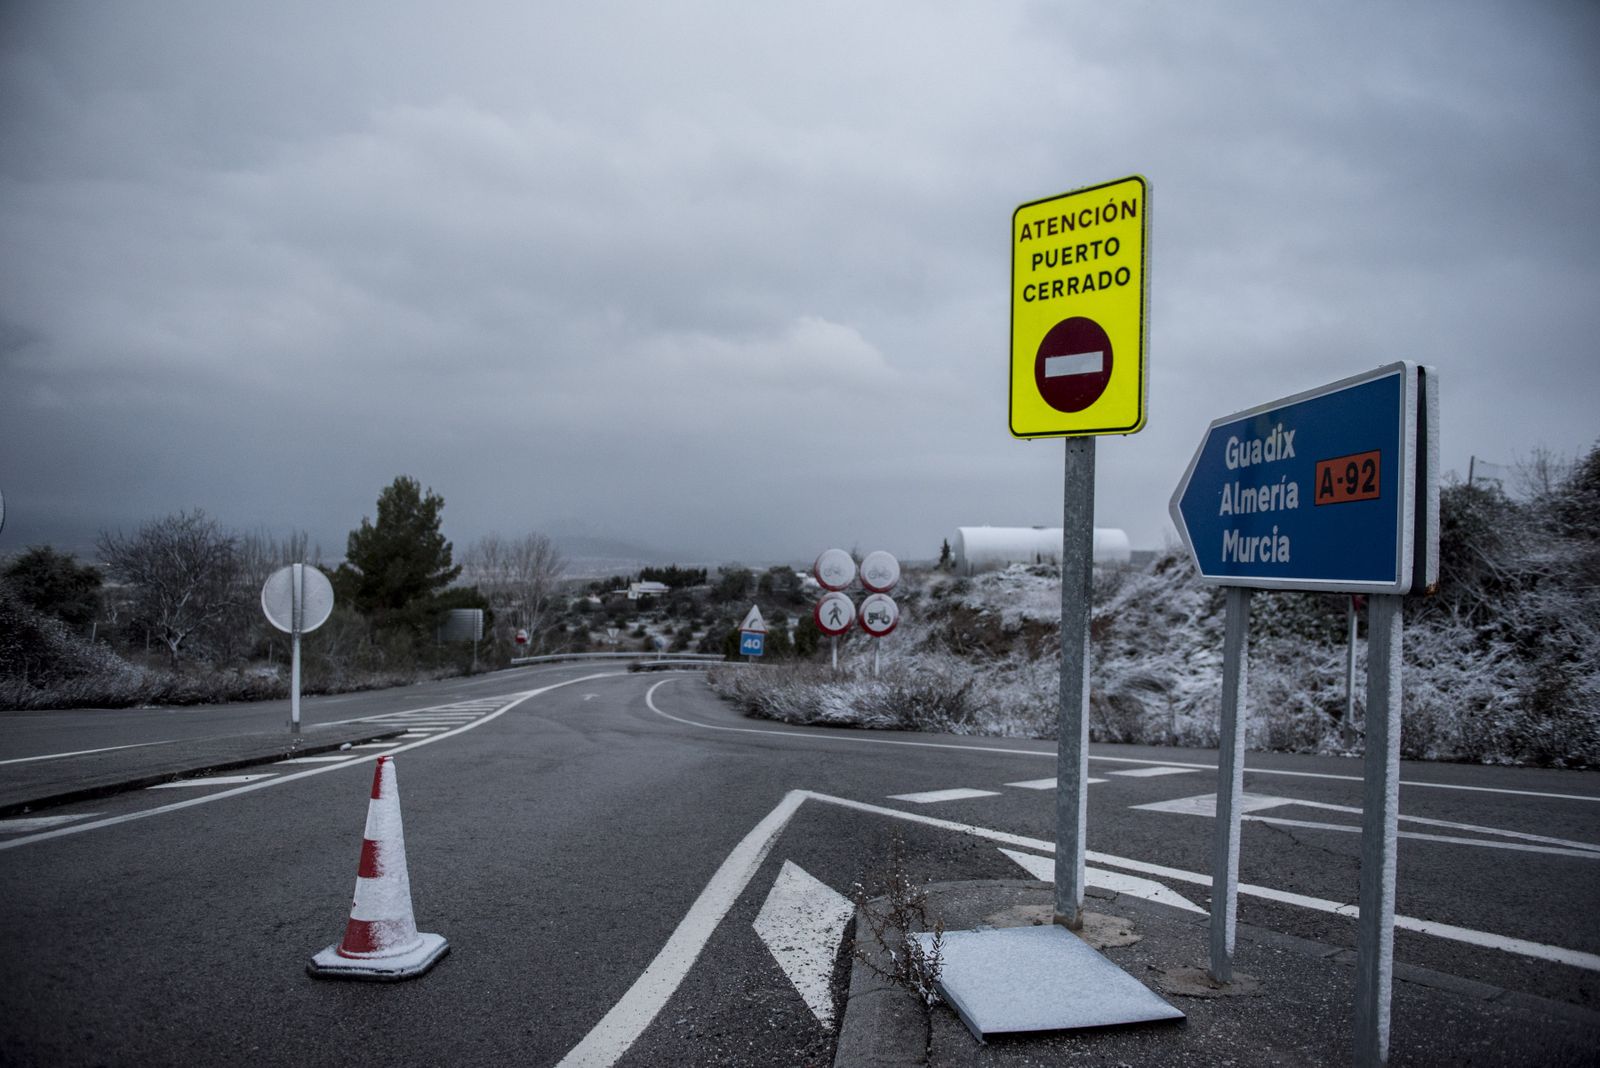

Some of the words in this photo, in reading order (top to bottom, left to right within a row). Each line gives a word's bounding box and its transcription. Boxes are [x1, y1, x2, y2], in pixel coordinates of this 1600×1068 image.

[1020, 198, 1137, 242] ATENCIÓN
[1032, 237, 1120, 271] PUERTO
[1023, 266, 1131, 302] CERRADO
[1225, 423, 1296, 470] Guadix
[1219, 475, 1299, 517] Almería
[1319, 458, 1376, 499] A-92
[1222, 525, 1290, 564] Murcia
[744, 639, 761, 649] 40
